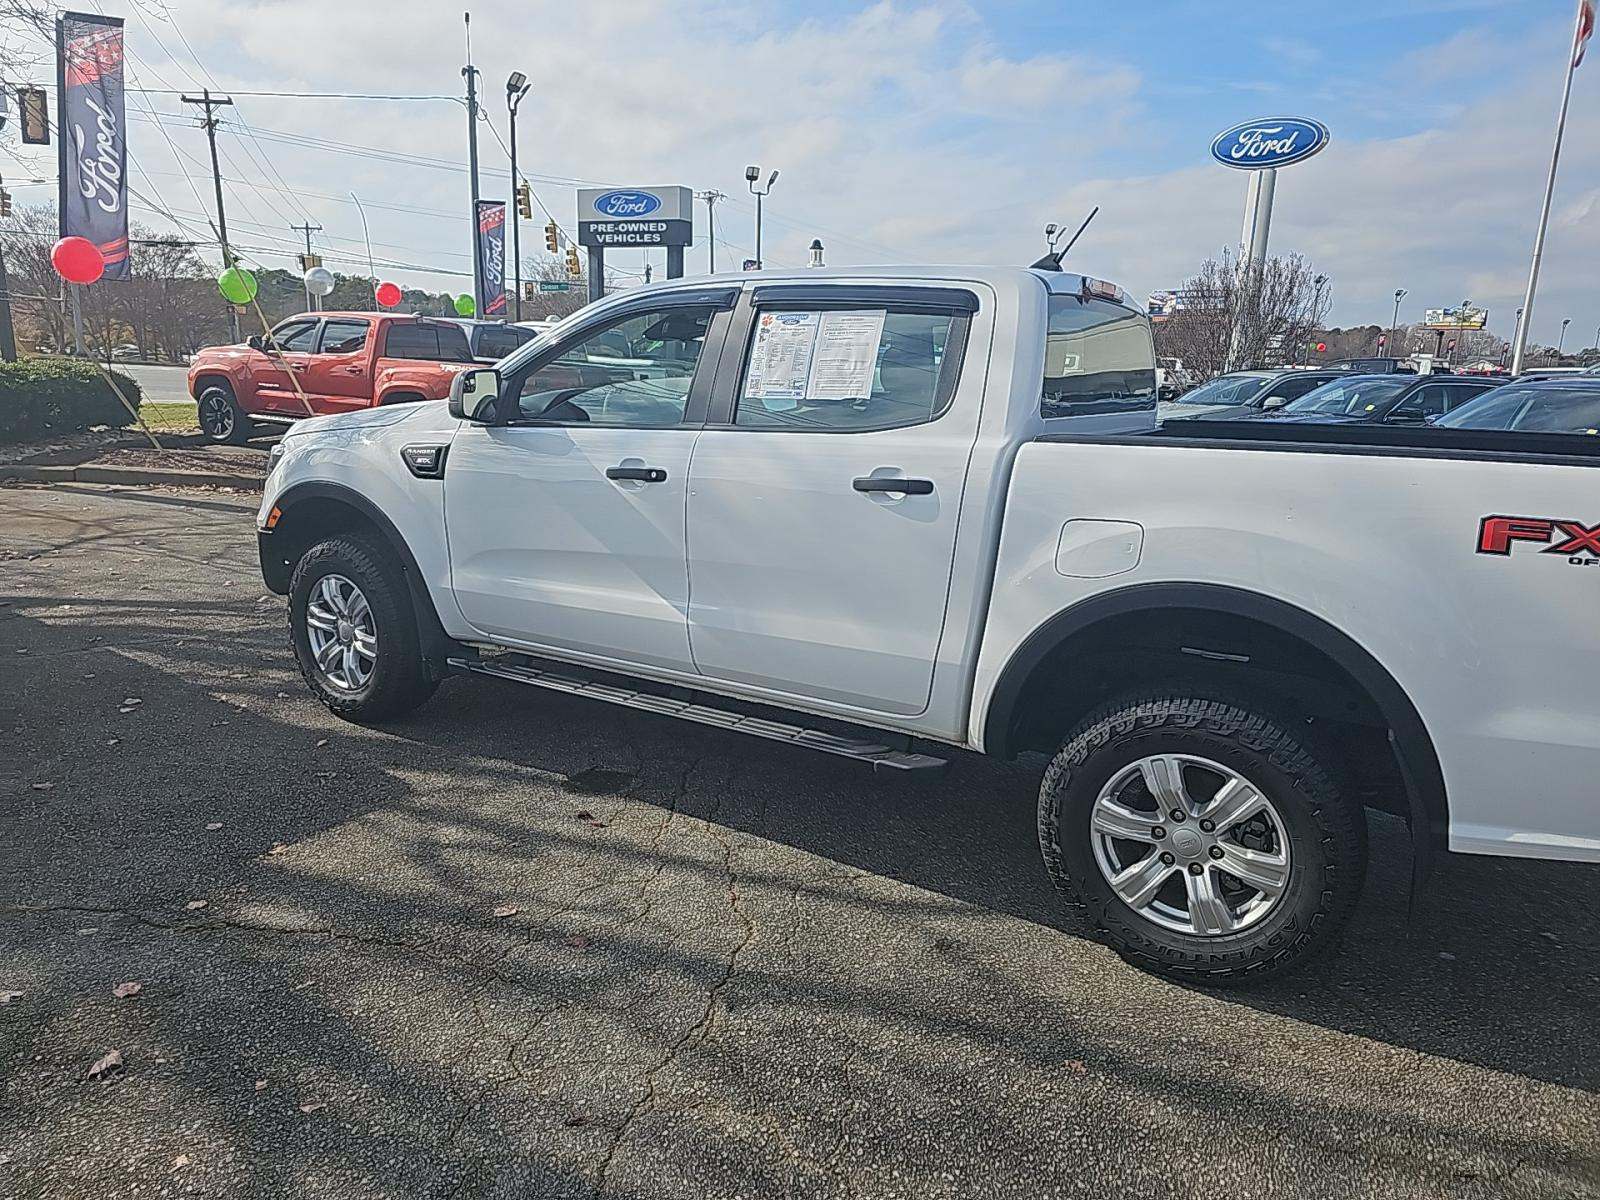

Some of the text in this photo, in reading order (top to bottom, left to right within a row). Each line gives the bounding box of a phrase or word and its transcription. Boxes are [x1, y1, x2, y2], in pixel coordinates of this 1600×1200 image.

[1231, 127, 1299, 158] Ford
[75, 98, 121, 213] Ford
[607, 195, 647, 214] Ford
[590, 223, 667, 232] PRE-OWNED
[596, 234, 661, 243] VEHICLES
[486, 235, 503, 285] Ford
[1568, 557, 1600, 566] OF
